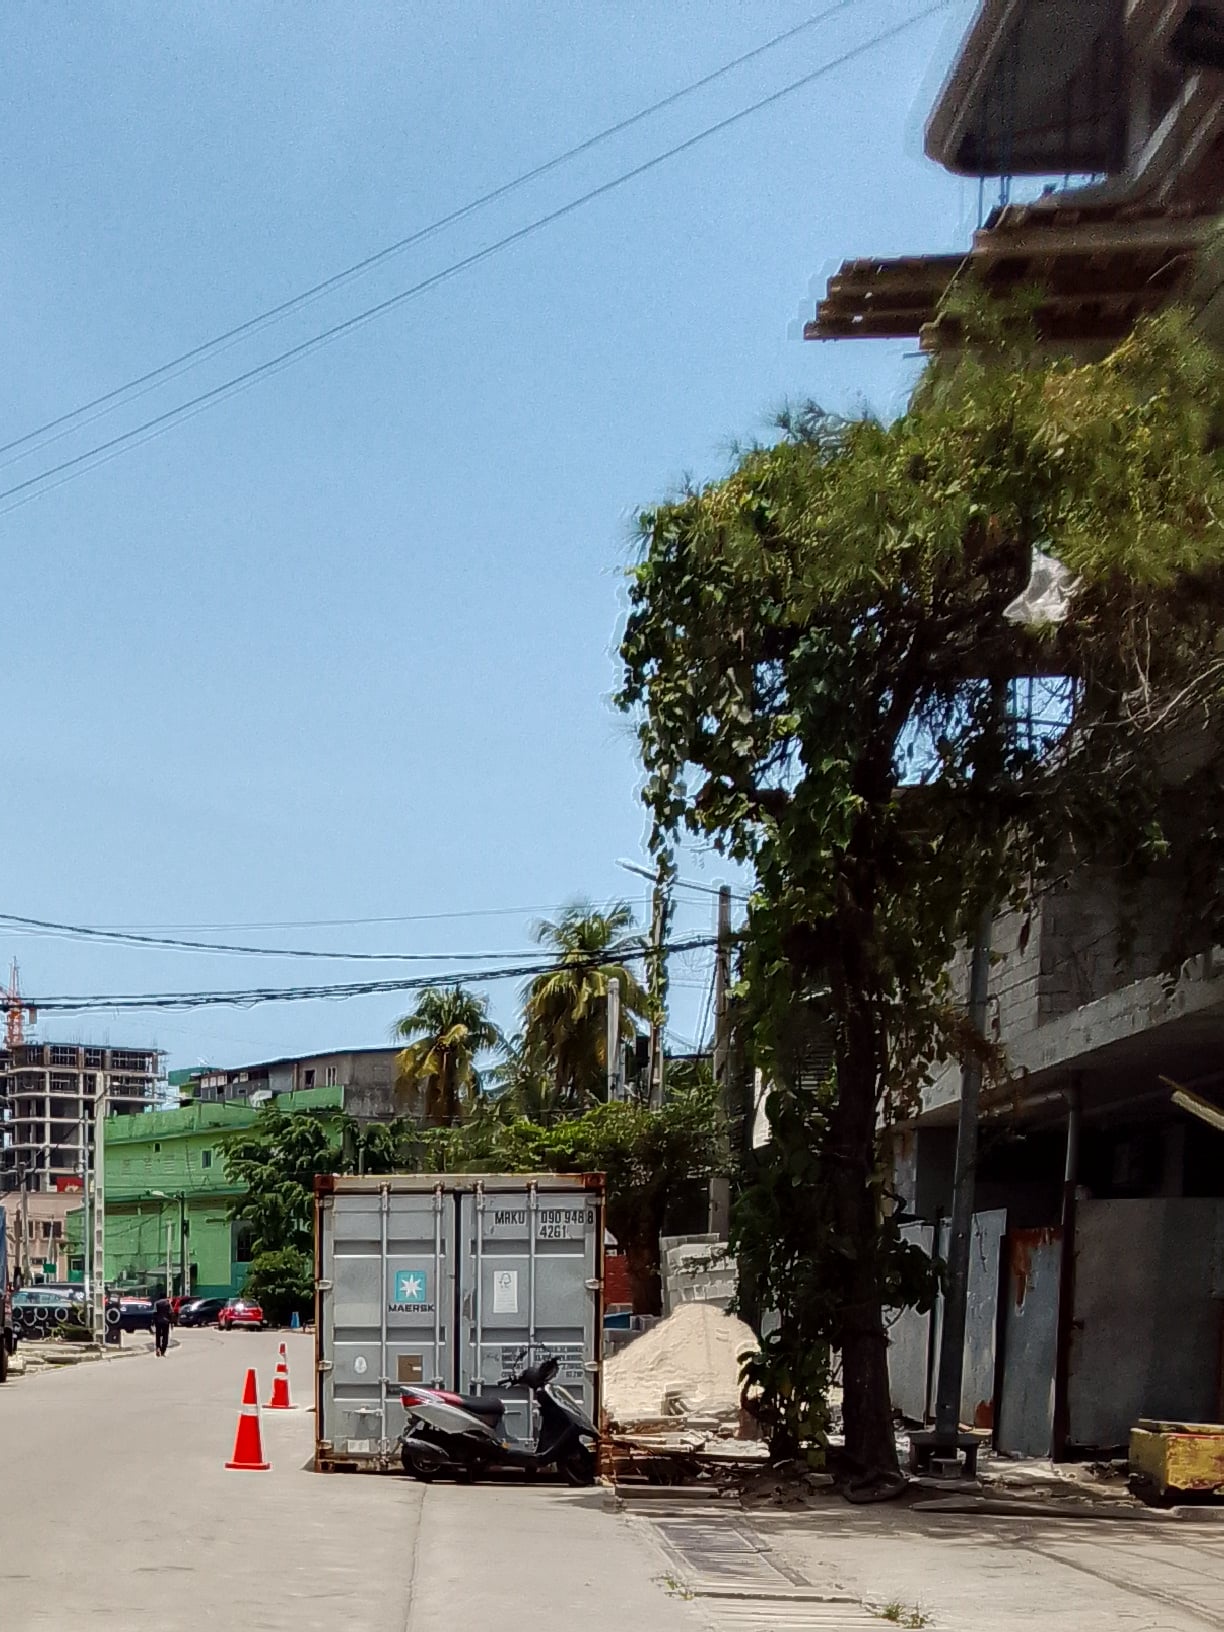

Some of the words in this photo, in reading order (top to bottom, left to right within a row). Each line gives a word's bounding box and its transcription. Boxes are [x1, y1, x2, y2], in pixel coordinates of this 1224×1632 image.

[540, 1210, 561, 1224] 090
[587, 1210, 594, 1224] 8
[388, 1304, 435, 1312] MAERSK
